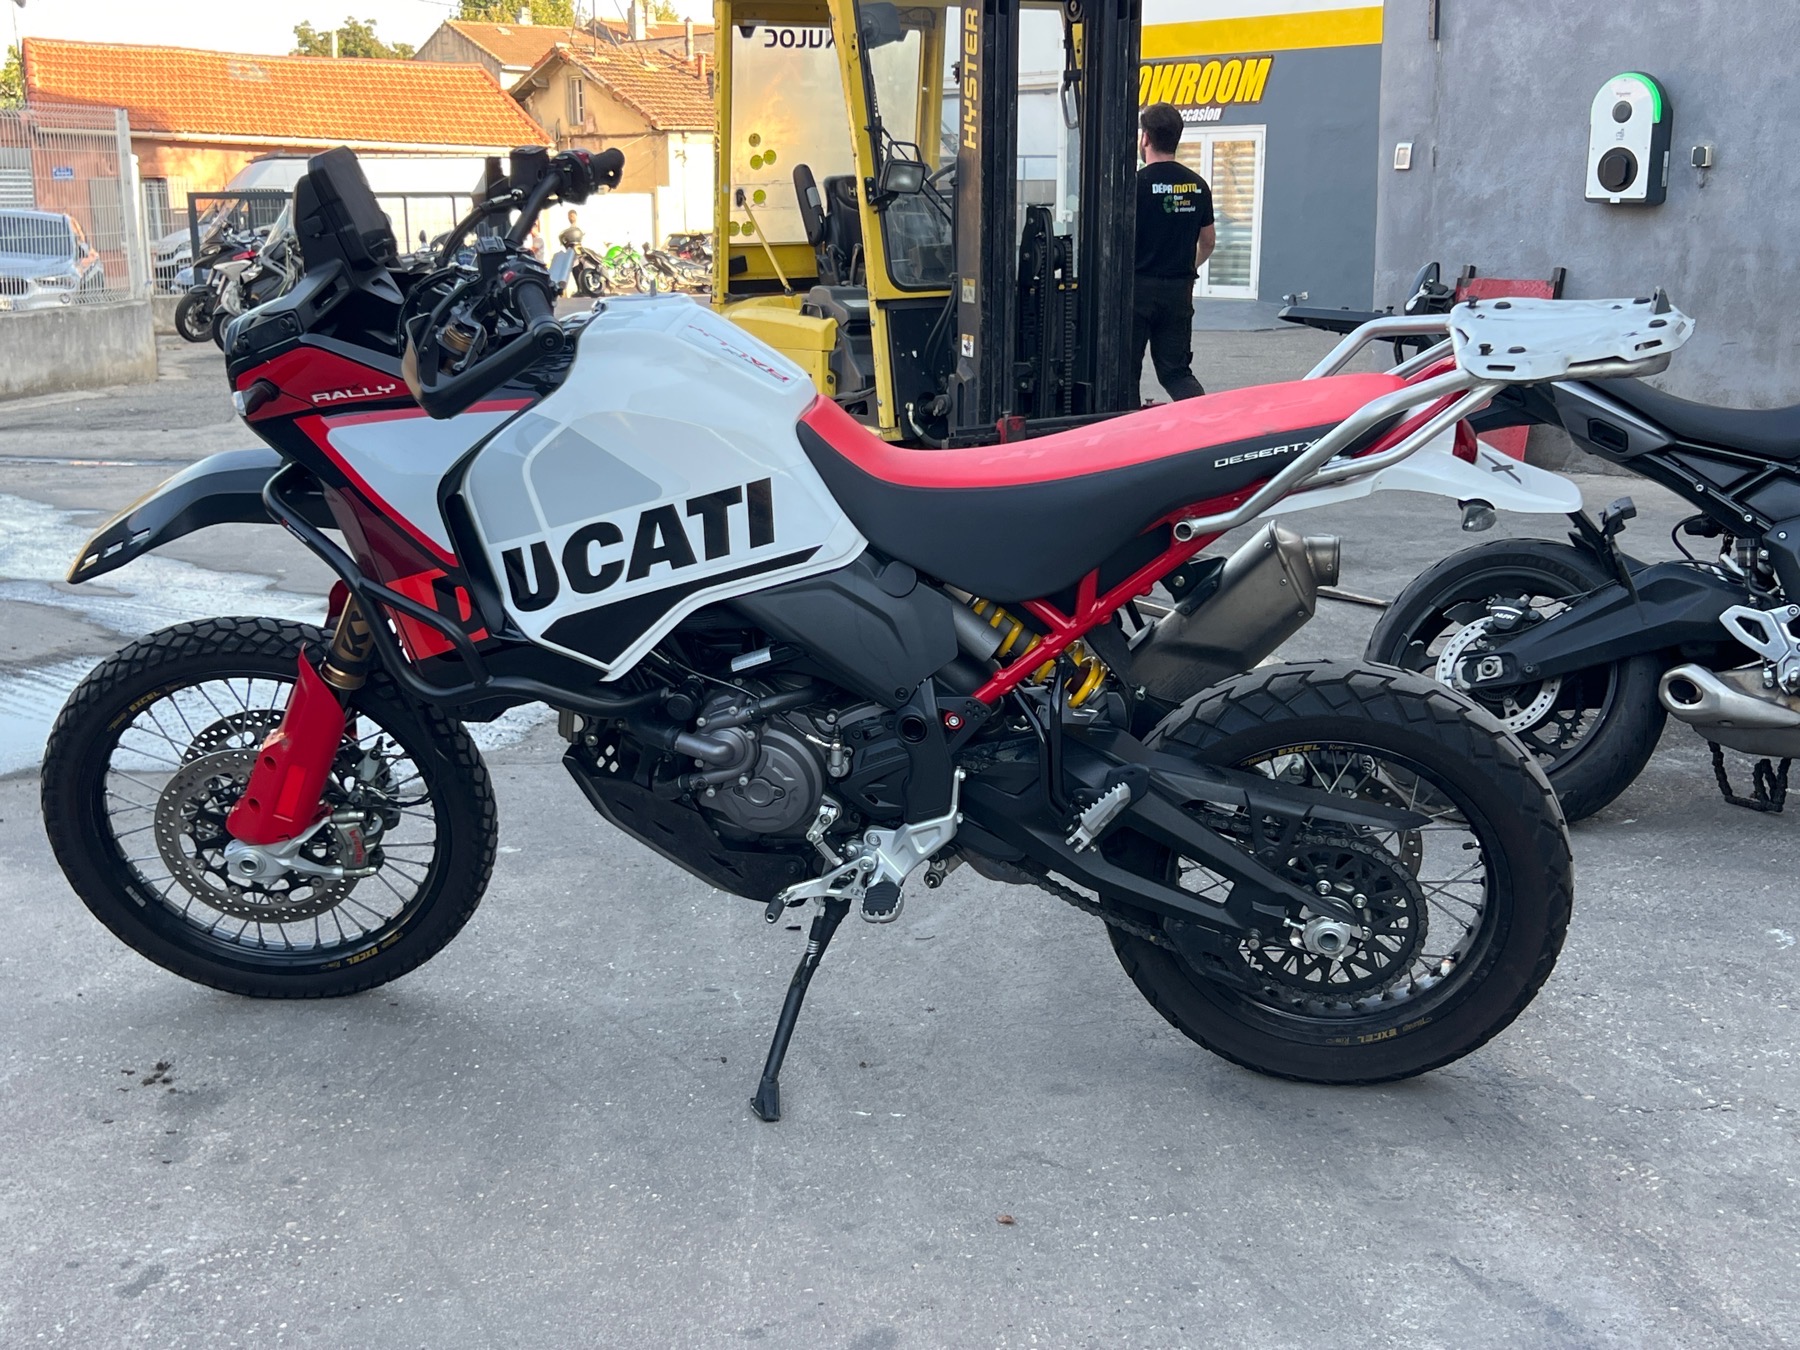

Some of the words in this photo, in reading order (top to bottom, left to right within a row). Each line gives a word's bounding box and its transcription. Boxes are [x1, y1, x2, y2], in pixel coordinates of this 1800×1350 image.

[963, 7, 978, 150] HYSTER
[1179, 106, 1222, 122] ccasion
[311, 383, 396, 403] RALLY
[1214, 438, 1320, 468] DESERTX
[1278, 744, 1321, 756] EXCEL
[1357, 1027, 1398, 1043] EXCEL
